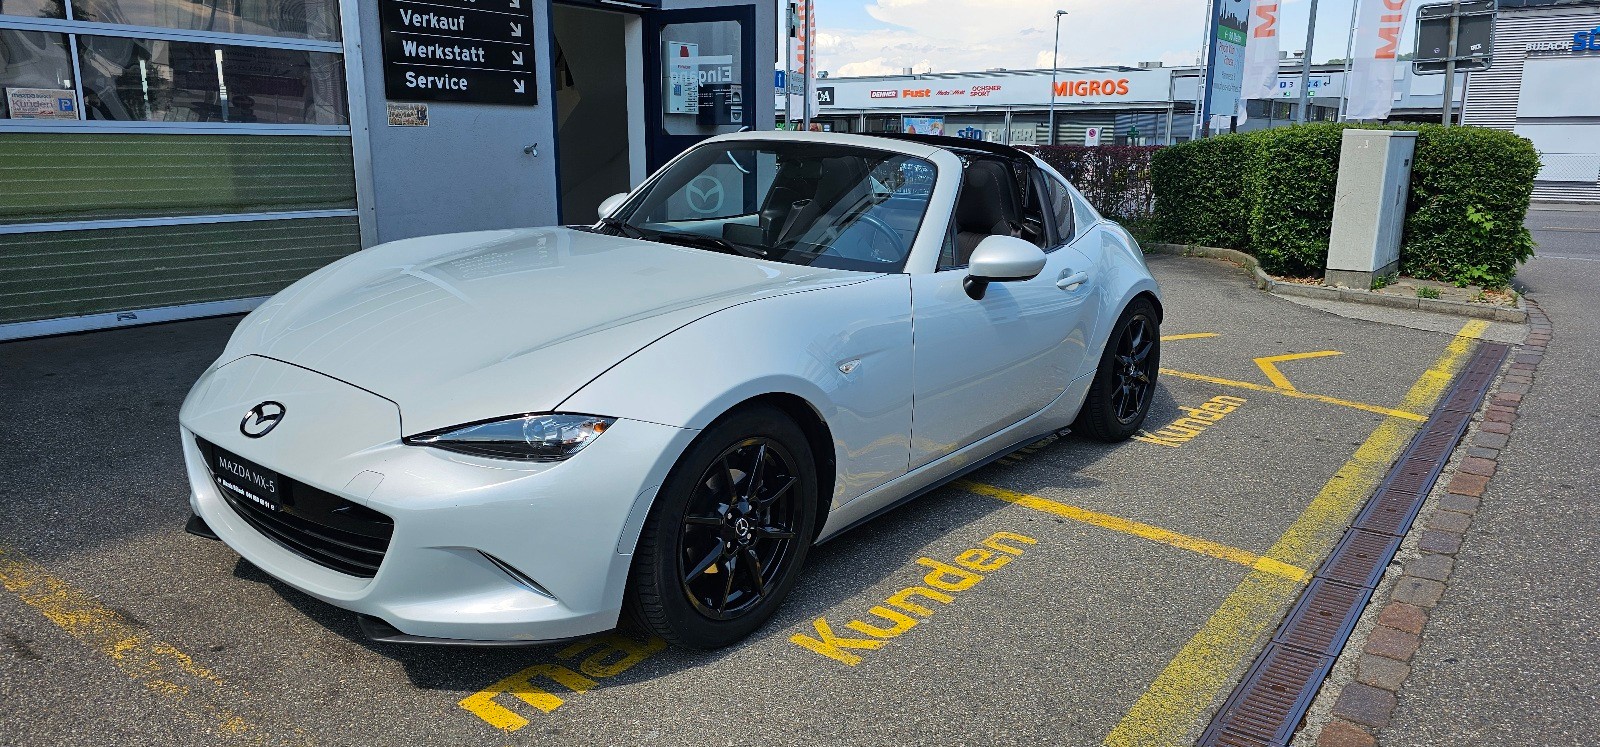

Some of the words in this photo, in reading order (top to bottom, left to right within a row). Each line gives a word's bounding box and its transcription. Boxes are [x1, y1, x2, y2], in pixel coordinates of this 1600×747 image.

[399, 8, 465, 31] Verkauf
[402, 39, 486, 63] Werkstatt
[405, 71, 469, 91] Service
[1051, 78, 1130, 97] MIGROS
[11, 99, 53, 108] Kunden
[871, 90, 897, 98] DENNER
[902, 88, 931, 98] Fust
[1129, 395, 1247, 448] Kunden
[219, 456, 252, 482] MAZDA
[252, 471, 275, 494] MX-5
[789, 529, 1038, 667] Kunden
